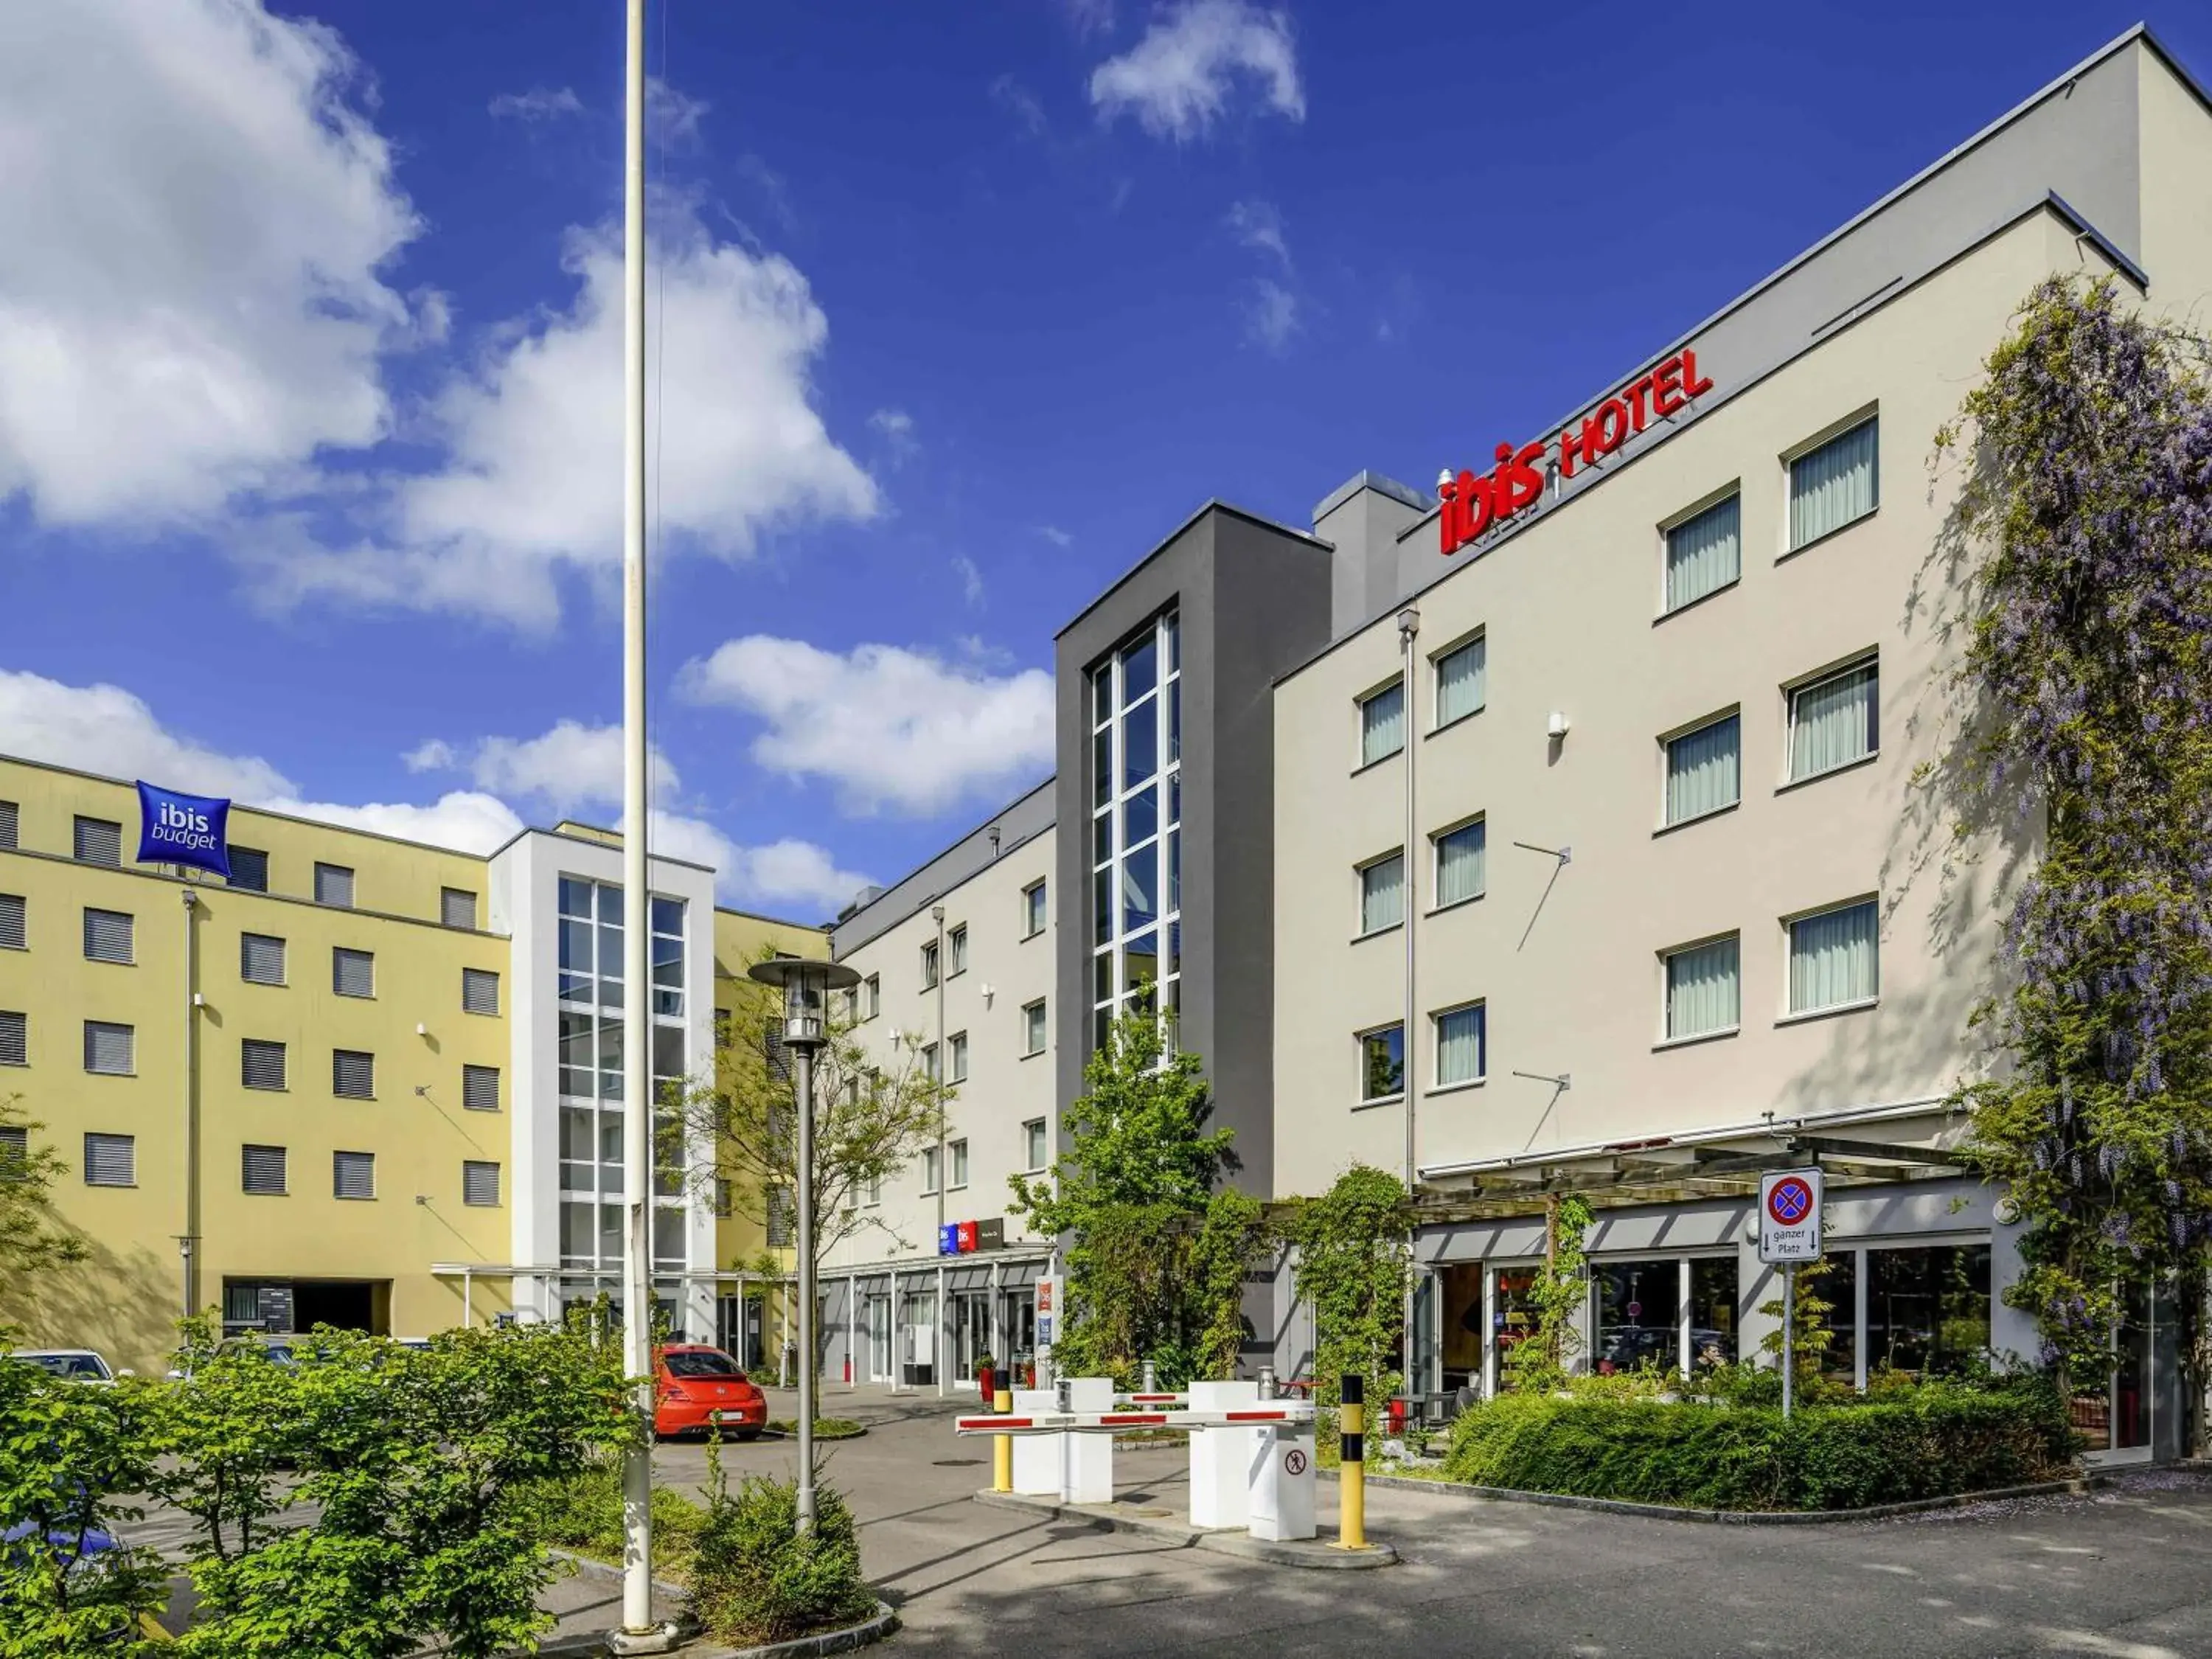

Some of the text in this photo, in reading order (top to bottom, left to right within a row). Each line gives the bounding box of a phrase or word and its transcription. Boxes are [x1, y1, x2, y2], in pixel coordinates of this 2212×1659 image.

[1440, 348, 1714, 555] ibis HOTEL
[161, 801, 209, 832] ibis
[152, 822, 217, 850] budget
[1773, 1230, 1805, 1242] ganzer
[1778, 1244, 1801, 1253] Platz
